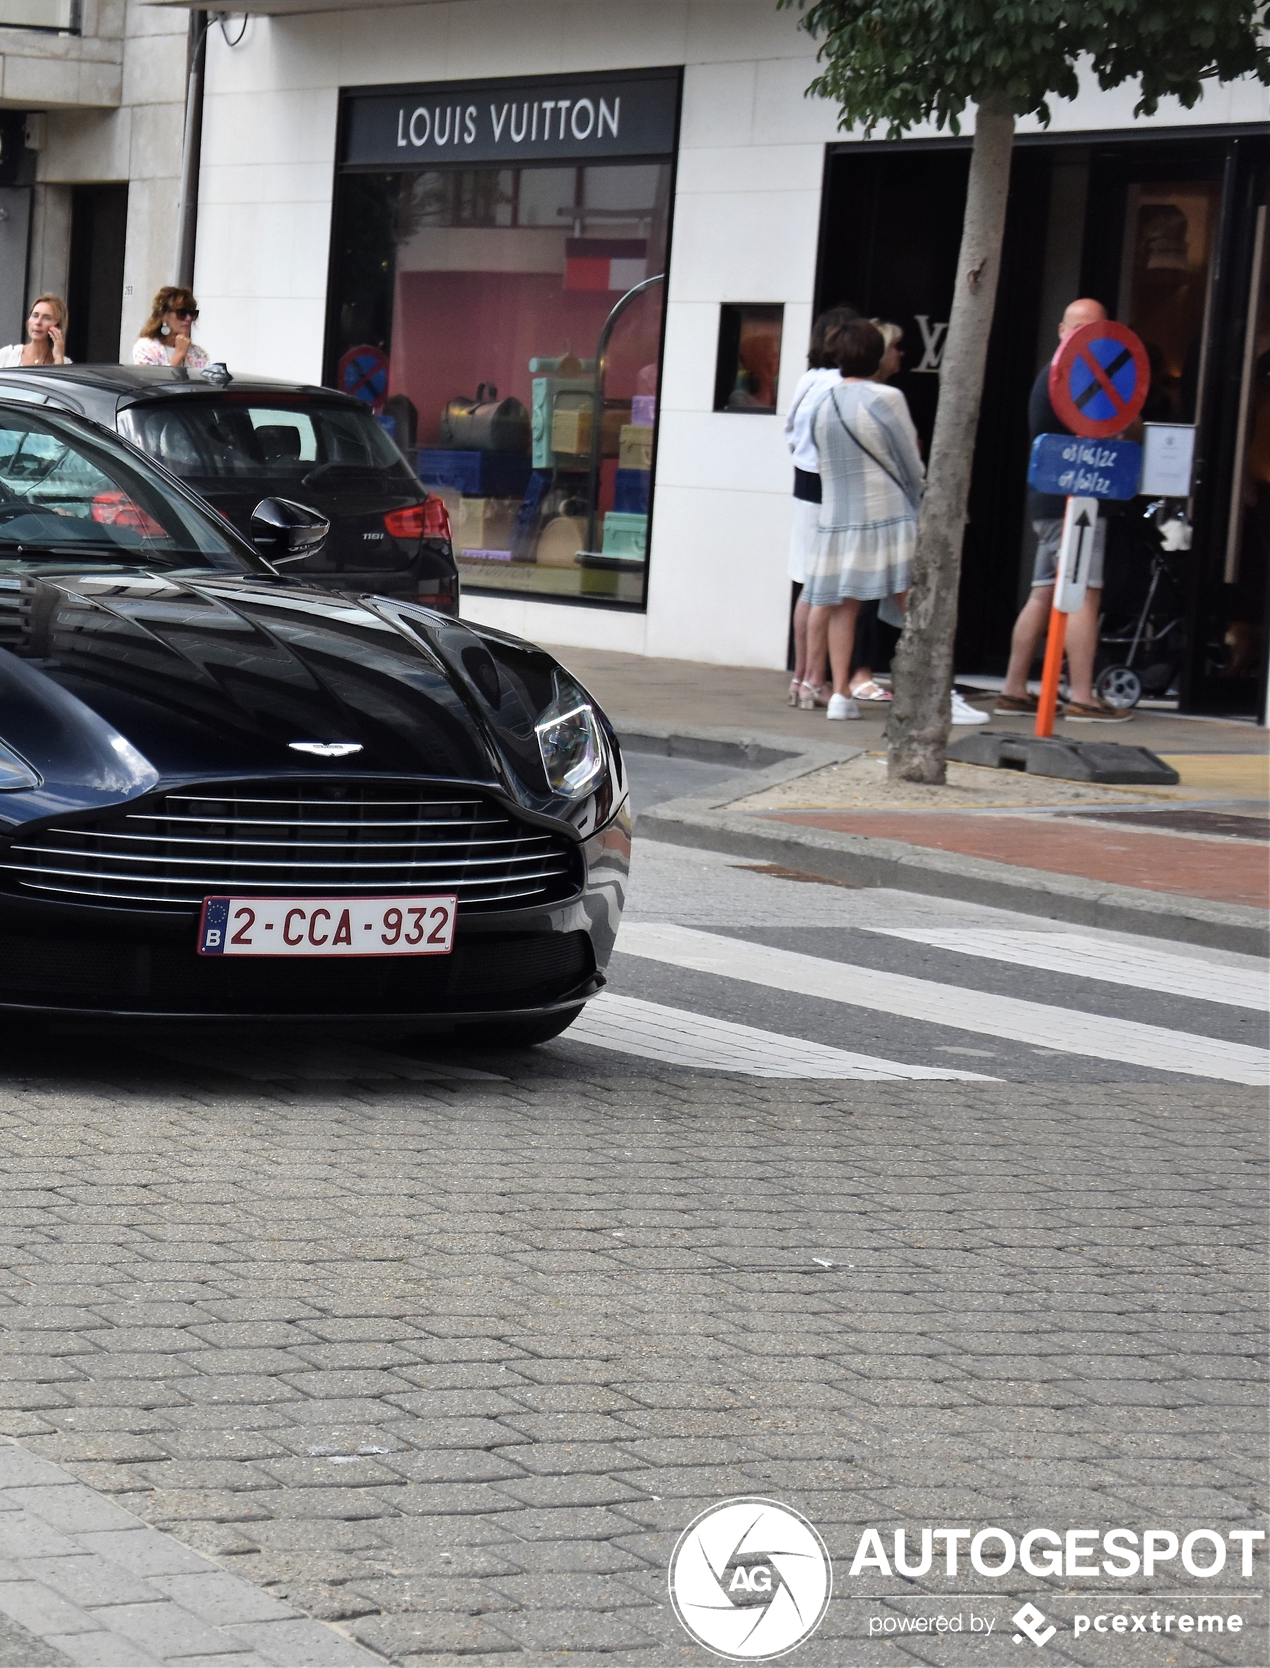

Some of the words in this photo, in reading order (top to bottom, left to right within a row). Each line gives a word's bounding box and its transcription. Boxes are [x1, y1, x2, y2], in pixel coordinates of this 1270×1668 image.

[397, 104, 478, 147] LOUIS
[490, 97, 620, 144] VUITTON
[205, 929, 221, 947] B
[231, 906, 449, 946] 2-CCA-932
